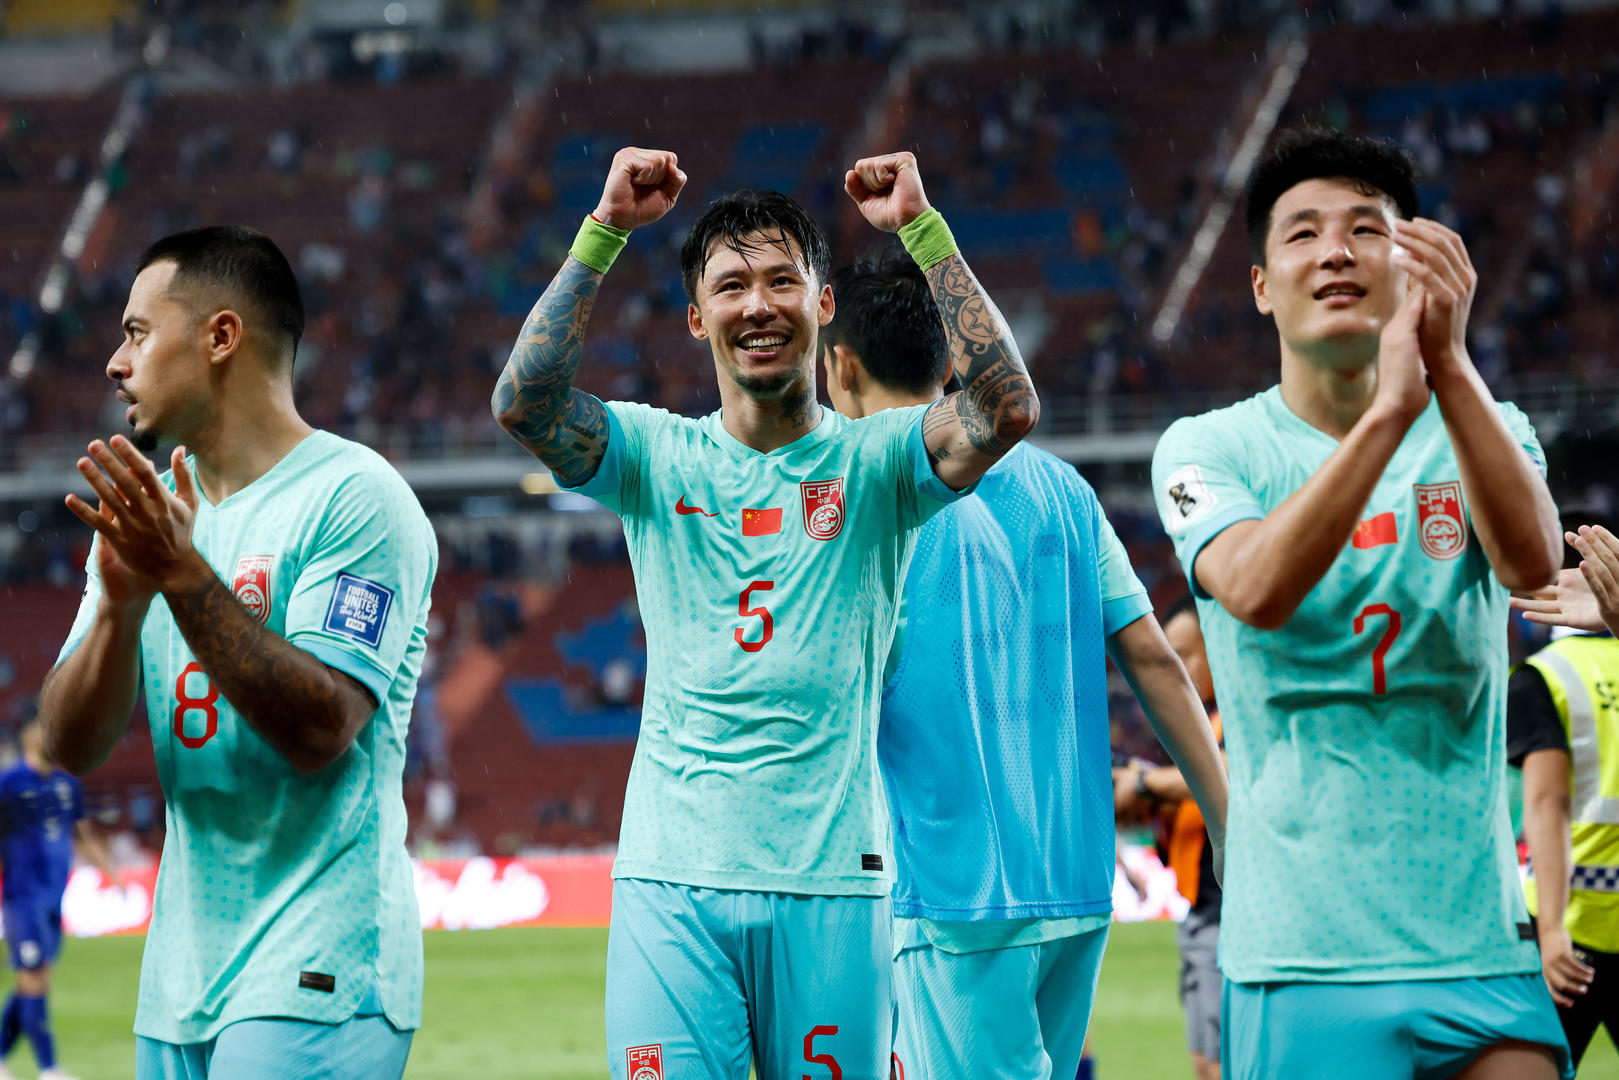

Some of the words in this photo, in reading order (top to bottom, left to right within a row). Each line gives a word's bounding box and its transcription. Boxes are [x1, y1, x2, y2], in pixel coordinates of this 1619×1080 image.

[806, 484, 839, 499] CFA
[1417, 488, 1456, 505] CFA
[344, 593, 378, 615] UNITES
[348, 585, 379, 603] FOOTBALL
[339, 606, 352, 616] the
[353, 608, 378, 626] World
[348, 620, 362, 629] FIFA
[734, 580, 774, 653] 5
[1353, 602, 1401, 695] 7
[1595, 678, 1619, 705] S
[173, 661, 219, 749] 8
[630, 1049, 657, 1061] CFA
[802, 1025, 842, 1080] 5
